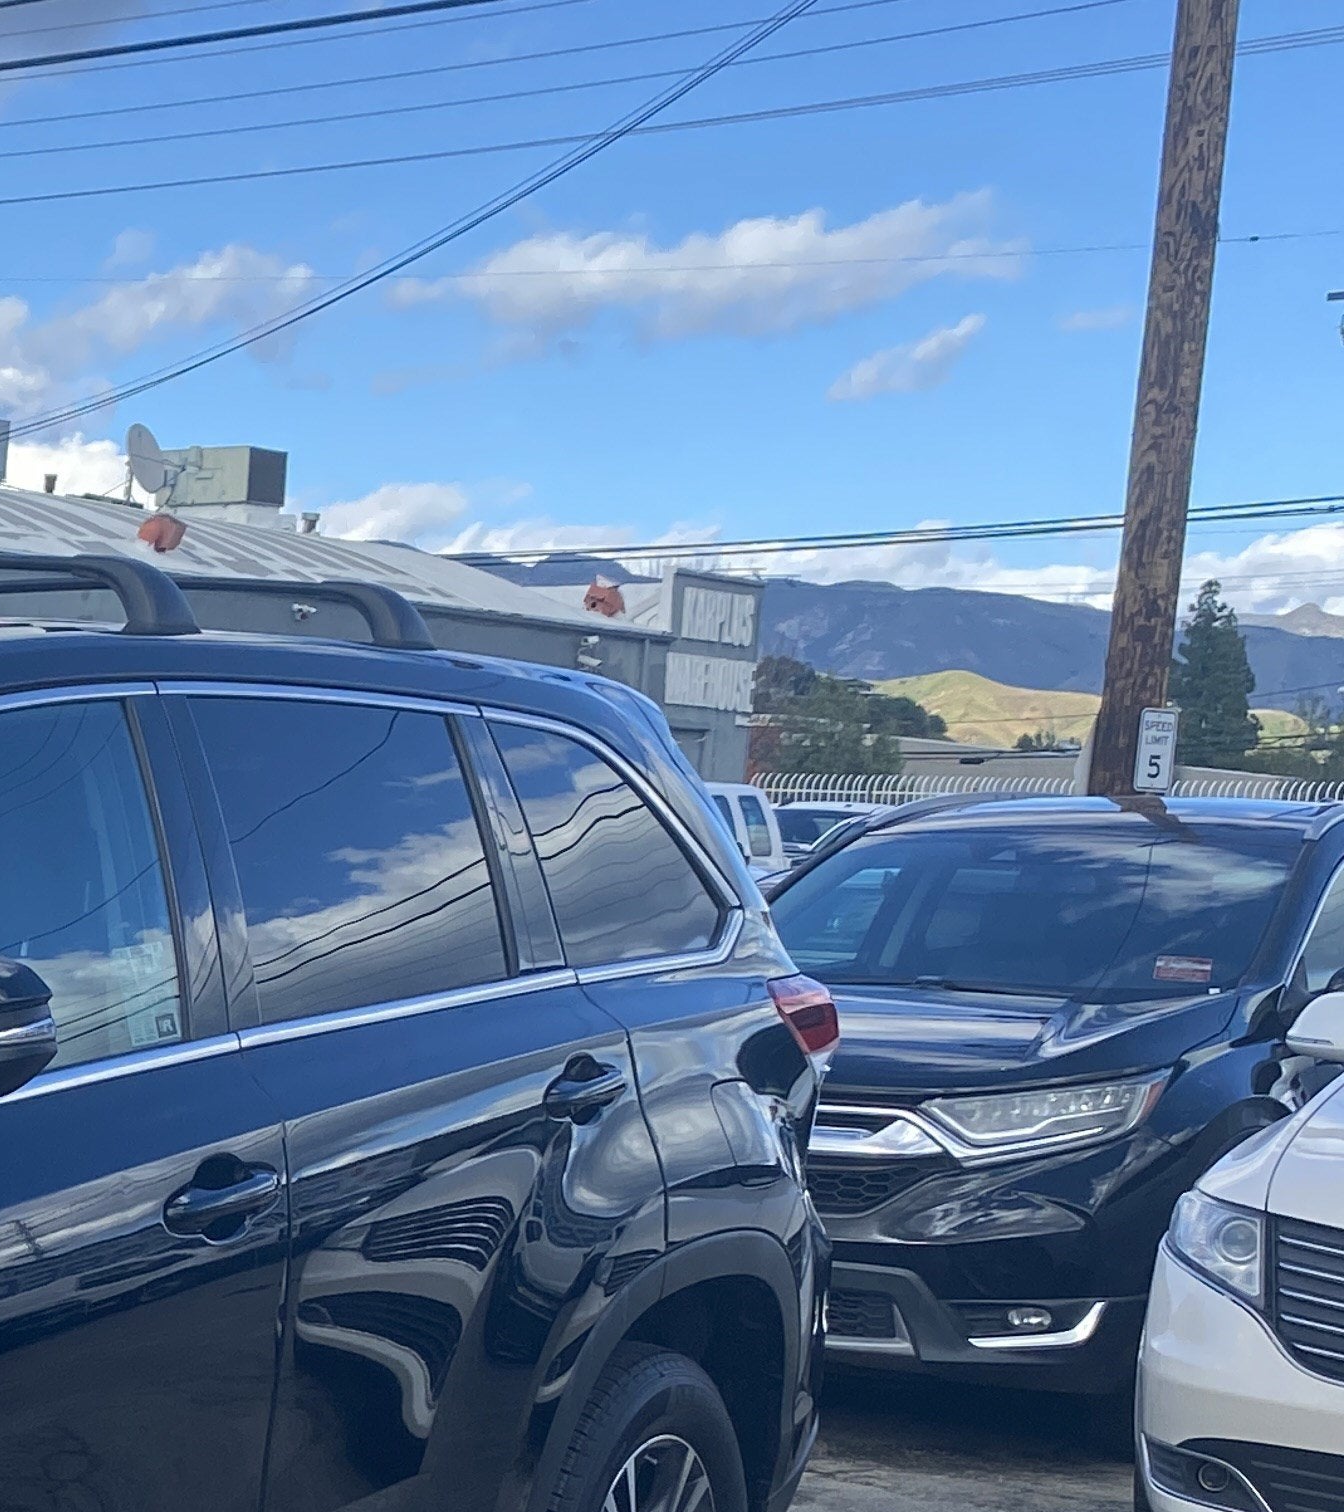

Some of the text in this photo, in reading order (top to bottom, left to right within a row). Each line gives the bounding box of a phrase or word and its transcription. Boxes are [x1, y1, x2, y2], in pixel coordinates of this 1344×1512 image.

[1144, 719, 1173, 733] SPEED
[1144, 735, 1170, 746] LIMIT
[1147, 754, 1161, 779] 5
